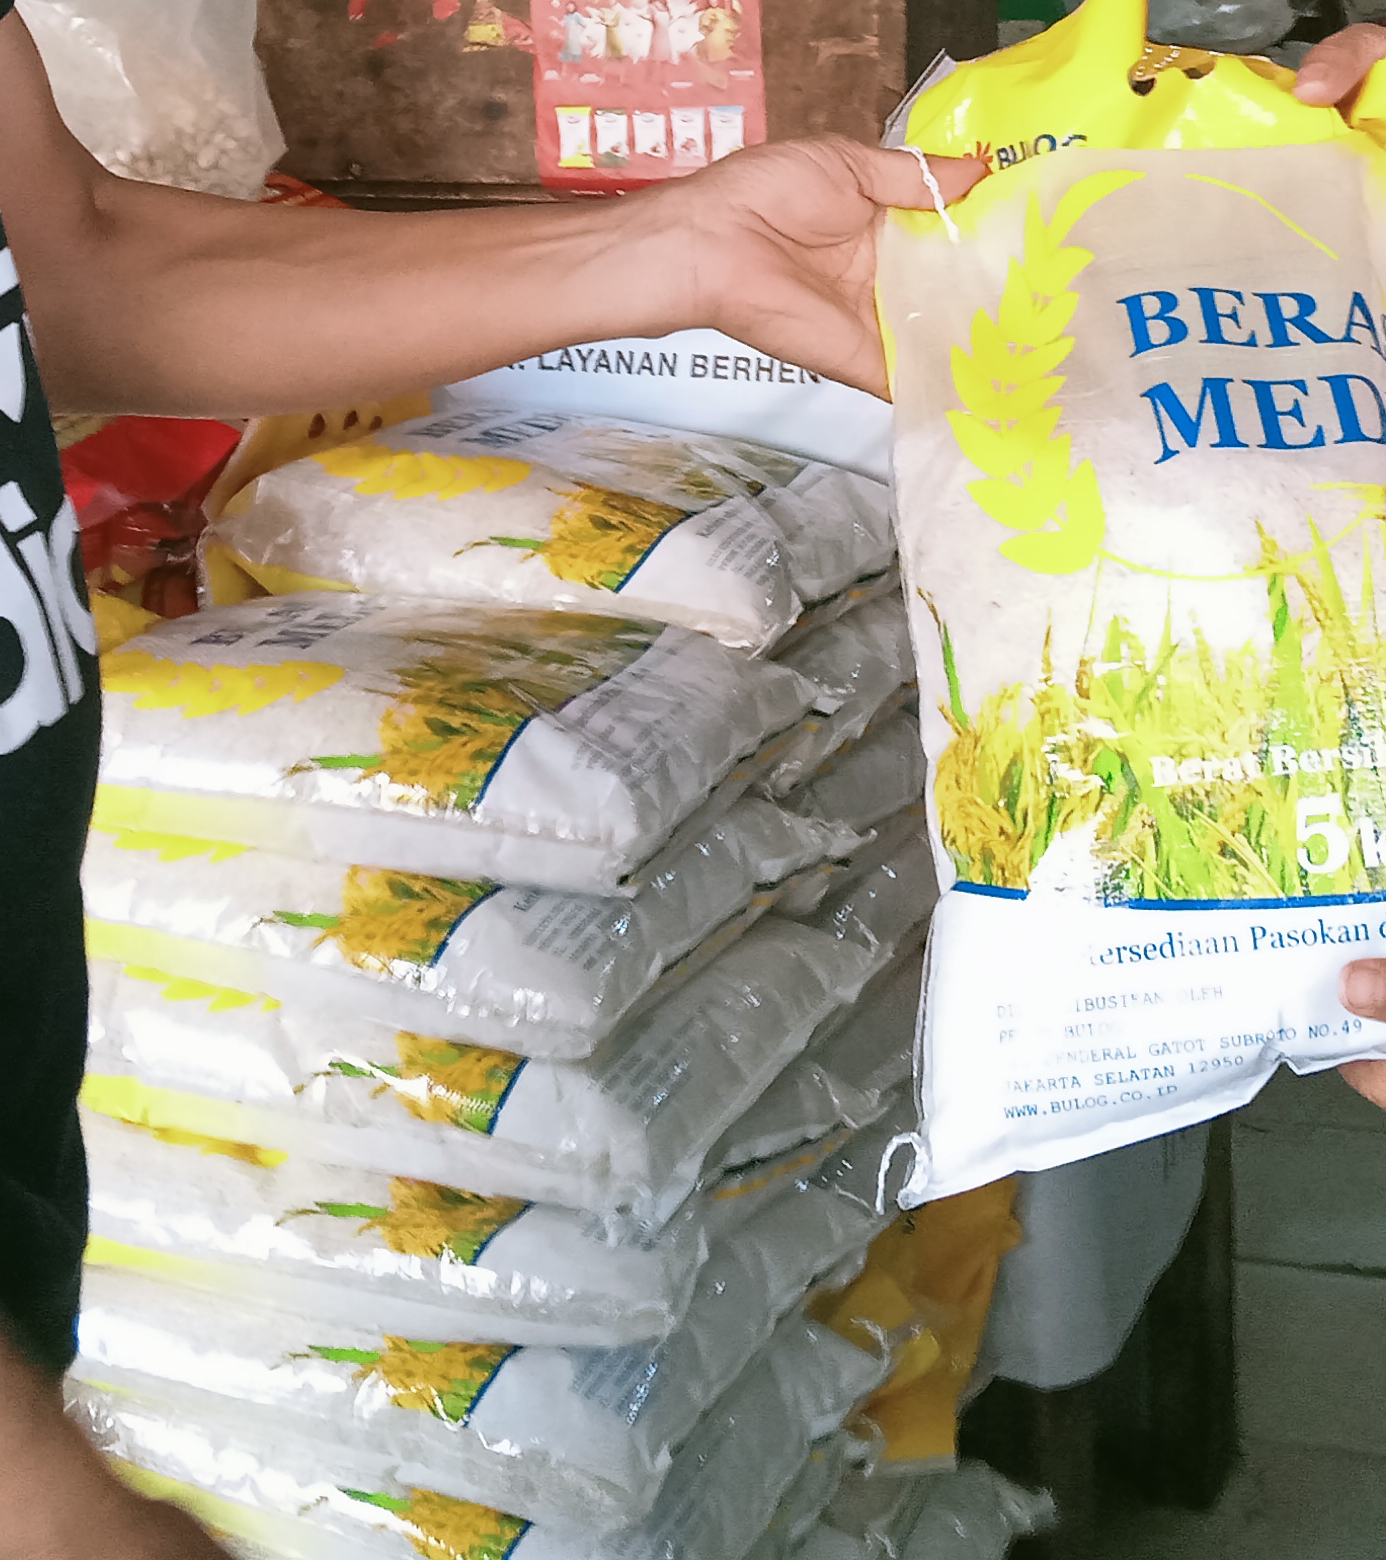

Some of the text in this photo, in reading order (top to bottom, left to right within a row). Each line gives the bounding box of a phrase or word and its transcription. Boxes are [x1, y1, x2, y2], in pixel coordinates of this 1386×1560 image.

[538, 347, 678, 378] LAYANAN
[1296, 792, 1351, 875] 5
[1250, 918, 1370, 951] Pasokan
[1148, 1036, 1208, 1059] GATOT
[1219, 1025, 1298, 1051] SUBROTO
[1308, 1018, 1364, 1040] NO.49
[1094, 1064, 1176, 1087] SELATAN
[1188, 1053, 1246, 1076] 12950
[1003, 1083, 1180, 1121] WWW.BULOG.CO.ID
